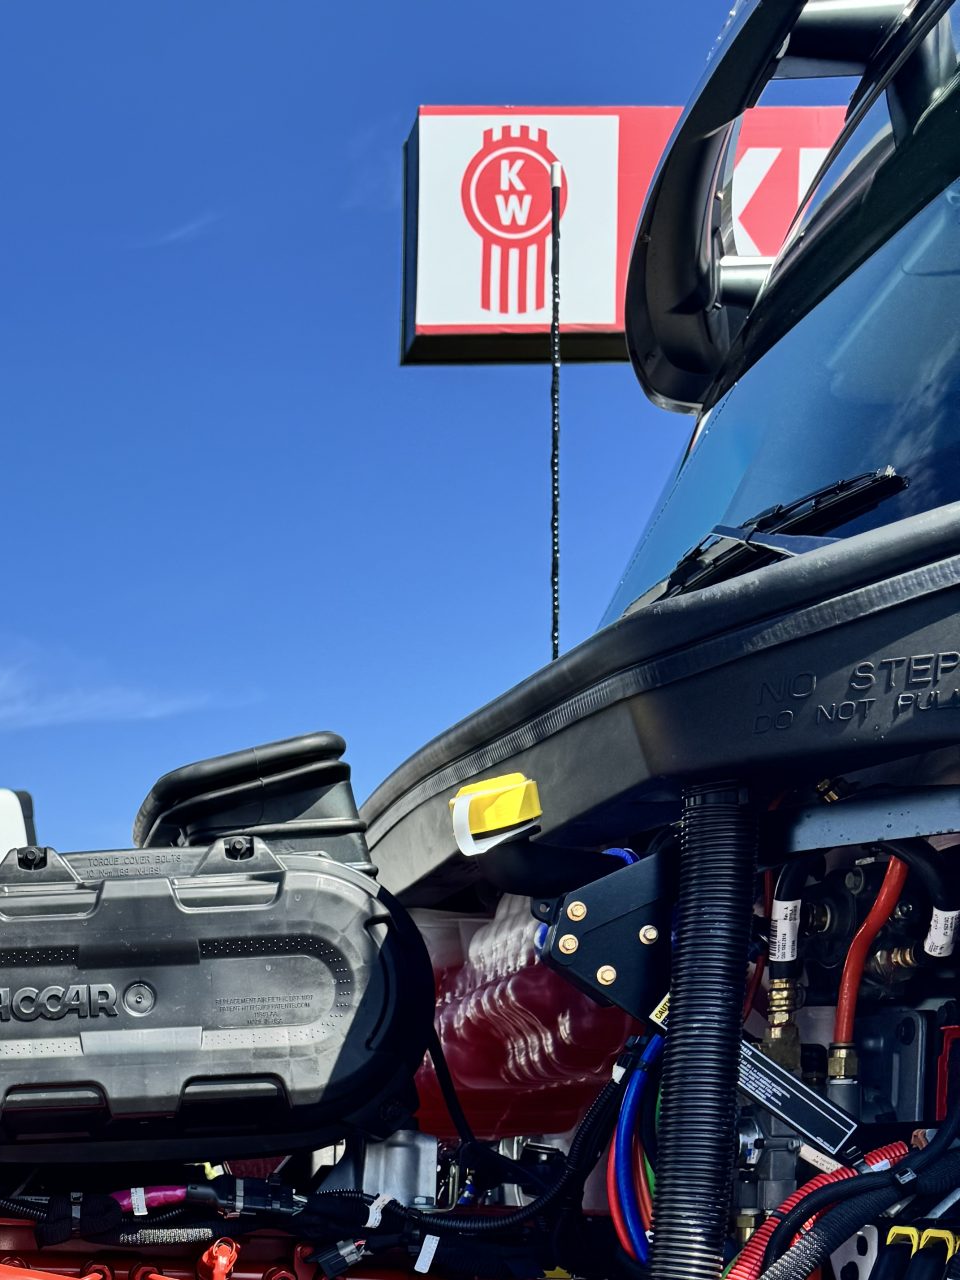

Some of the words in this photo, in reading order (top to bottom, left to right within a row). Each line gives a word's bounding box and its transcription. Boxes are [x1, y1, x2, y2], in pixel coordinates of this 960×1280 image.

[500, 159, 525, 191] K
[494, 194, 532, 225] W
[757, 671, 817, 705] NO
[850, 652, 960, 690] STEP
[753, 710, 794, 735] DO
[817, 698, 876, 724] NOT
[88, 858, 119, 866] TORQUE
[124, 856, 150, 864] COVER
[155, 854, 181, 863] BOLTS
[655, 1000, 670, 1019] CAUT
